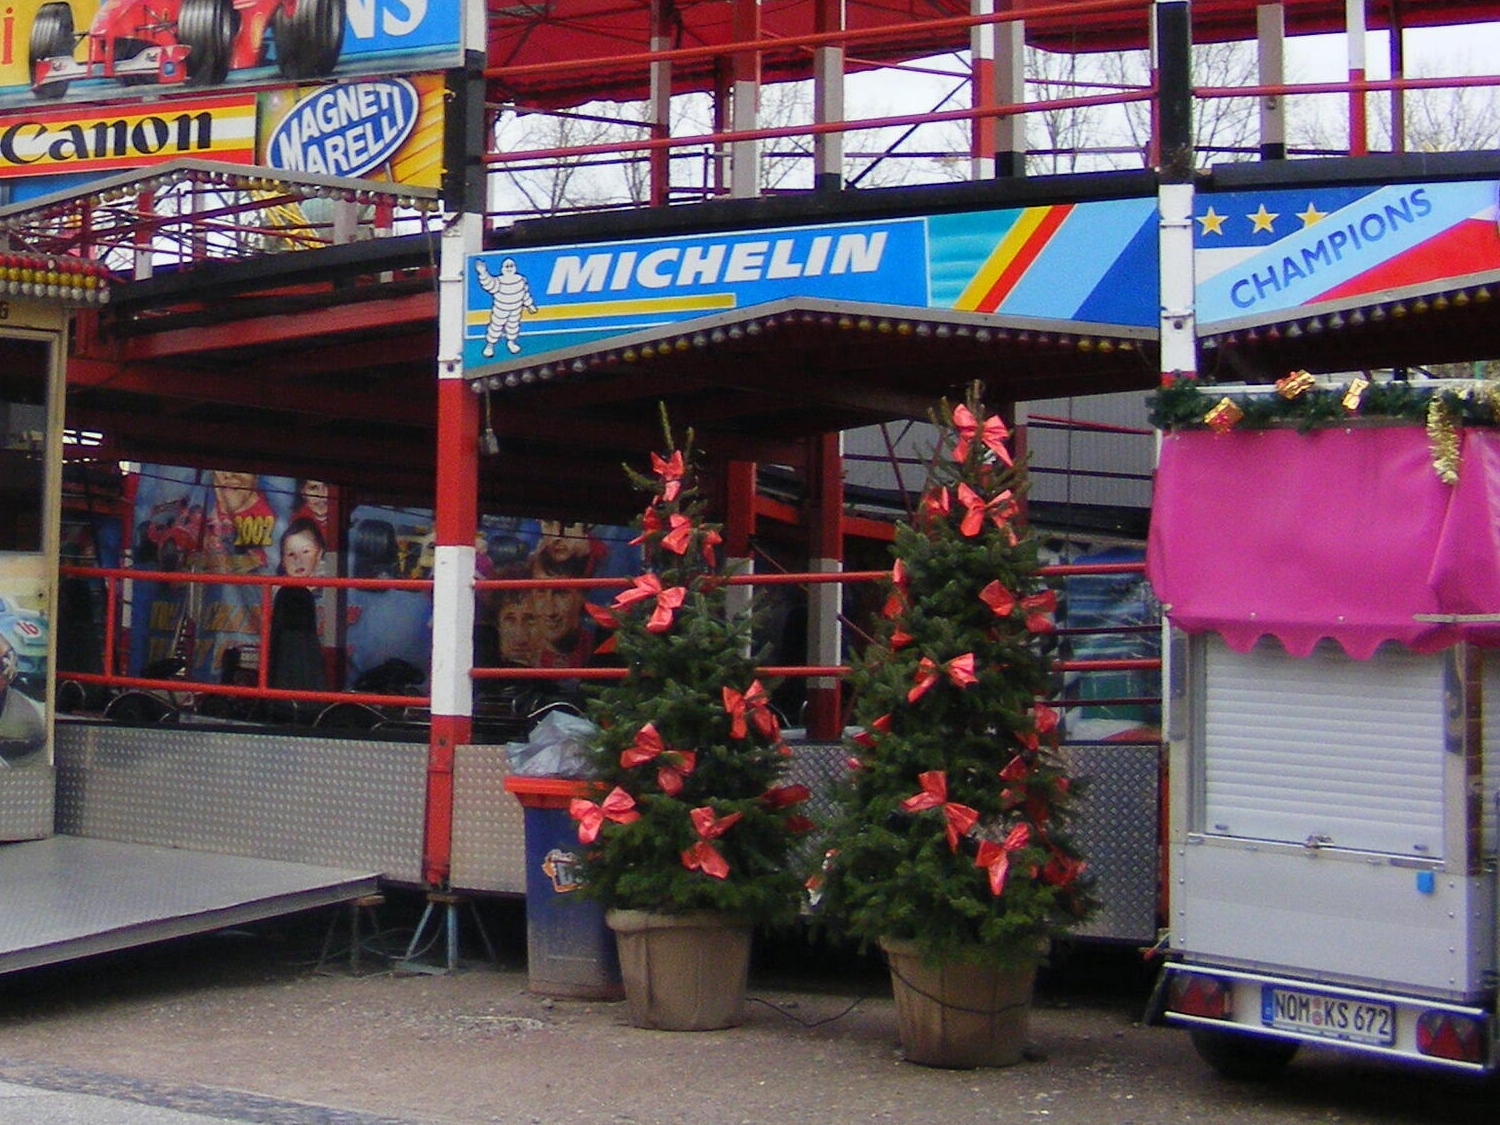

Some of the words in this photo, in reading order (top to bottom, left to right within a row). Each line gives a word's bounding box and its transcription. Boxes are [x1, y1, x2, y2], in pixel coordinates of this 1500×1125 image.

[0, 109, 213, 165] Canon
[546, 231, 888, 296] MICHELIN
[1230, 188, 1432, 309] CHAMPIONS
[16, 621, 40, 636] 16
[1275, 993, 1310, 1022] NOM
[1324, 1001, 1349, 1029] KS
[1354, 1005, 1390, 1035] 672
